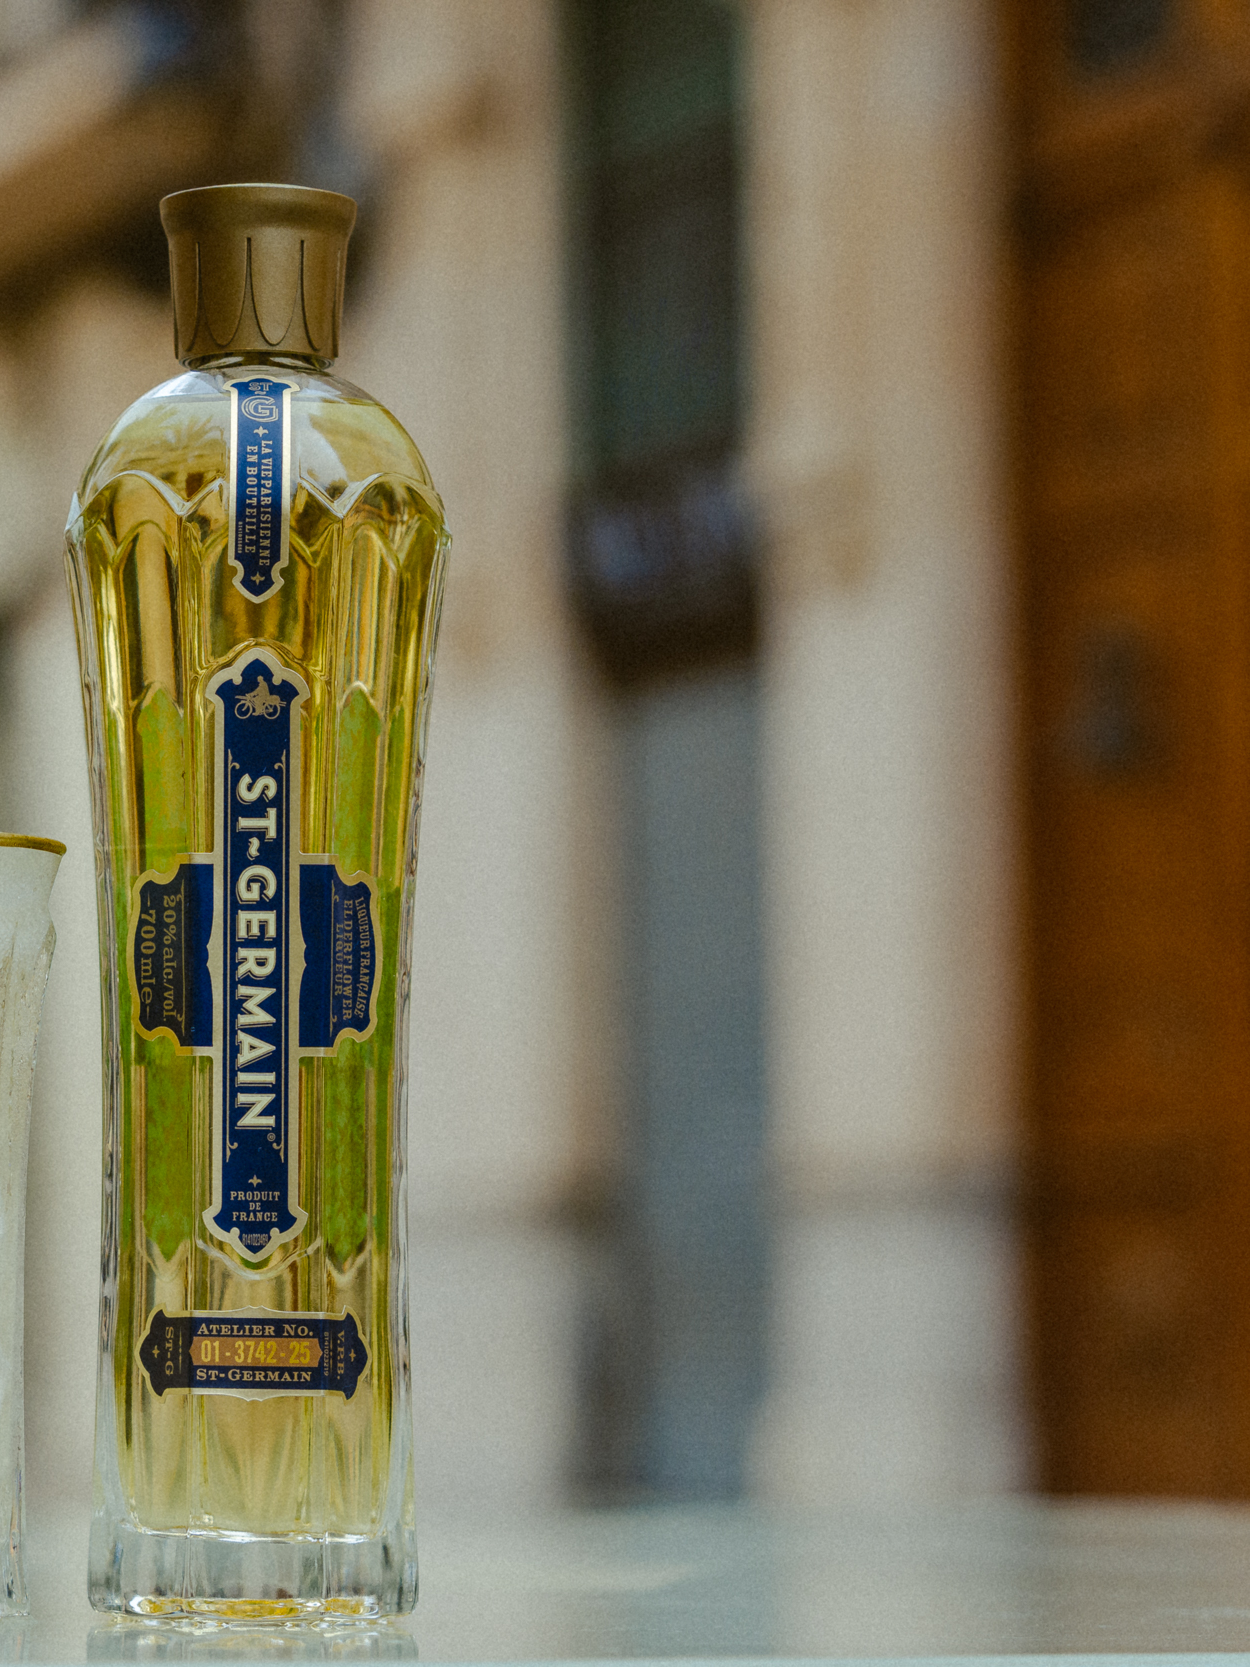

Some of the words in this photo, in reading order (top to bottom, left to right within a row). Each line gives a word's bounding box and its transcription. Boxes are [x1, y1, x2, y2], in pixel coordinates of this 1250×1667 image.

[248, 381, 273, 391] ST
[241, 395, 279, 423] G
[246, 445, 258, 463] EN
[261, 440, 273, 455] LA
[260, 458, 273, 478] VIE
[244, 466, 258, 553] BOUTEILLE
[258, 479, 273, 566] PARISIENNE
[163, 894, 177, 945] 20%
[354, 896, 371, 949] LIQUEUR
[334, 922, 344, 996] LIQUEUR
[342, 899, 353, 1021] ELDERFLOWER
[353, 950, 371, 1019] FRANÇAISE
[230, 1190, 281, 1201] PRODUIT
[248, 1202, 261, 1211] DE
[232, 1211, 278, 1222] FRANCE
[197, 1323, 275, 1336] ATELIER
[164, 1326, 175, 1377] ST-G
[196, 1368, 312, 1382] ST-GERMAIN
